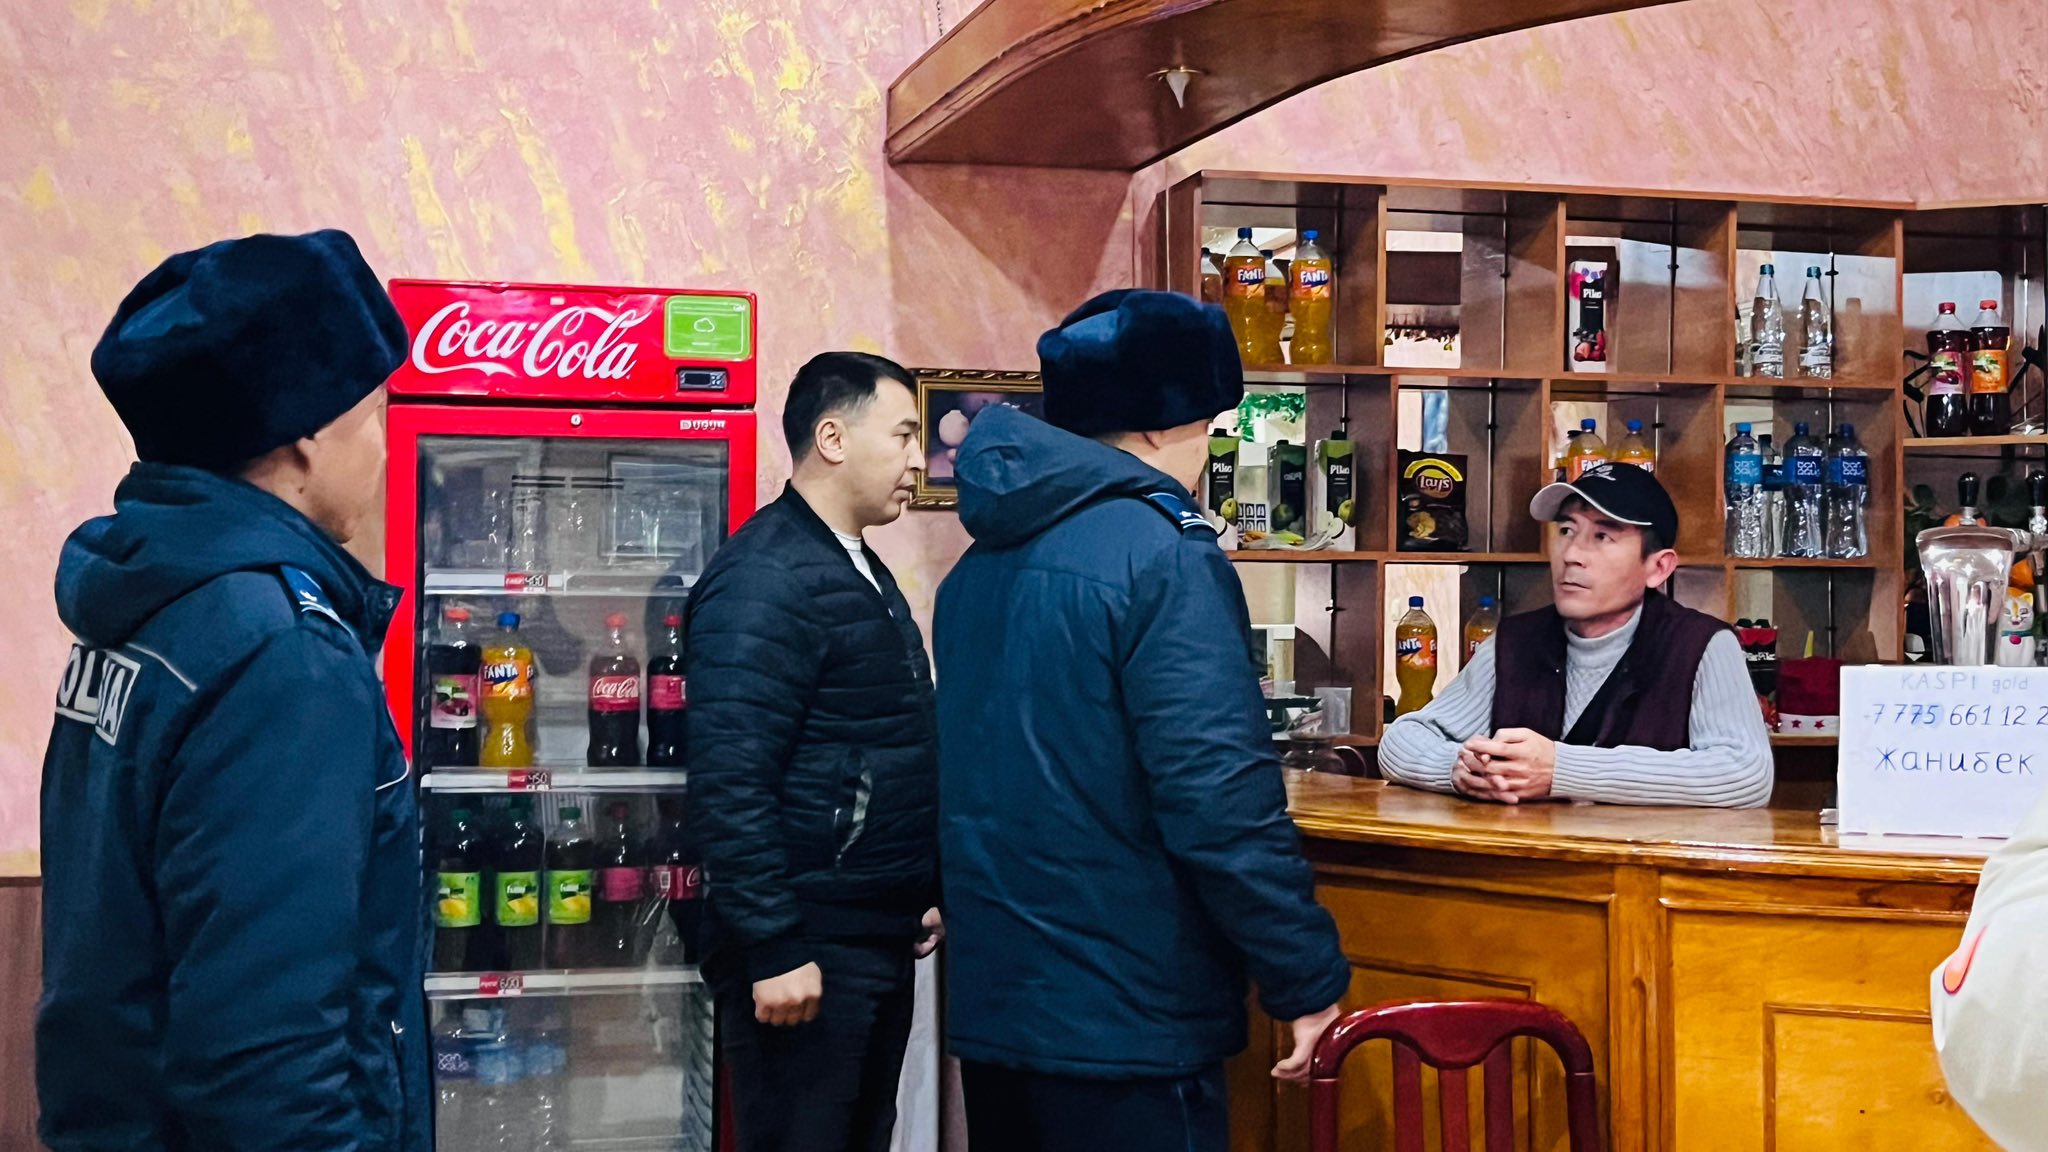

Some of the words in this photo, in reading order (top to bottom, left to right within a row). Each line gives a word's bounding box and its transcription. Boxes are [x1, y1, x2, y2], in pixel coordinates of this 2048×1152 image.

[412, 302, 652, 380] Coca-Cola
[1212, 462, 1233, 473] Piko
[1330, 464, 1350, 475] Piko
[1901, 671, 1978, 690] KASPI
[1992, 675, 2029, 694] gold
[1949, 703, 1992, 726] 661
[2000, 705, 2028, 726] 12
[1874, 746, 2035, 775] Жанибек
